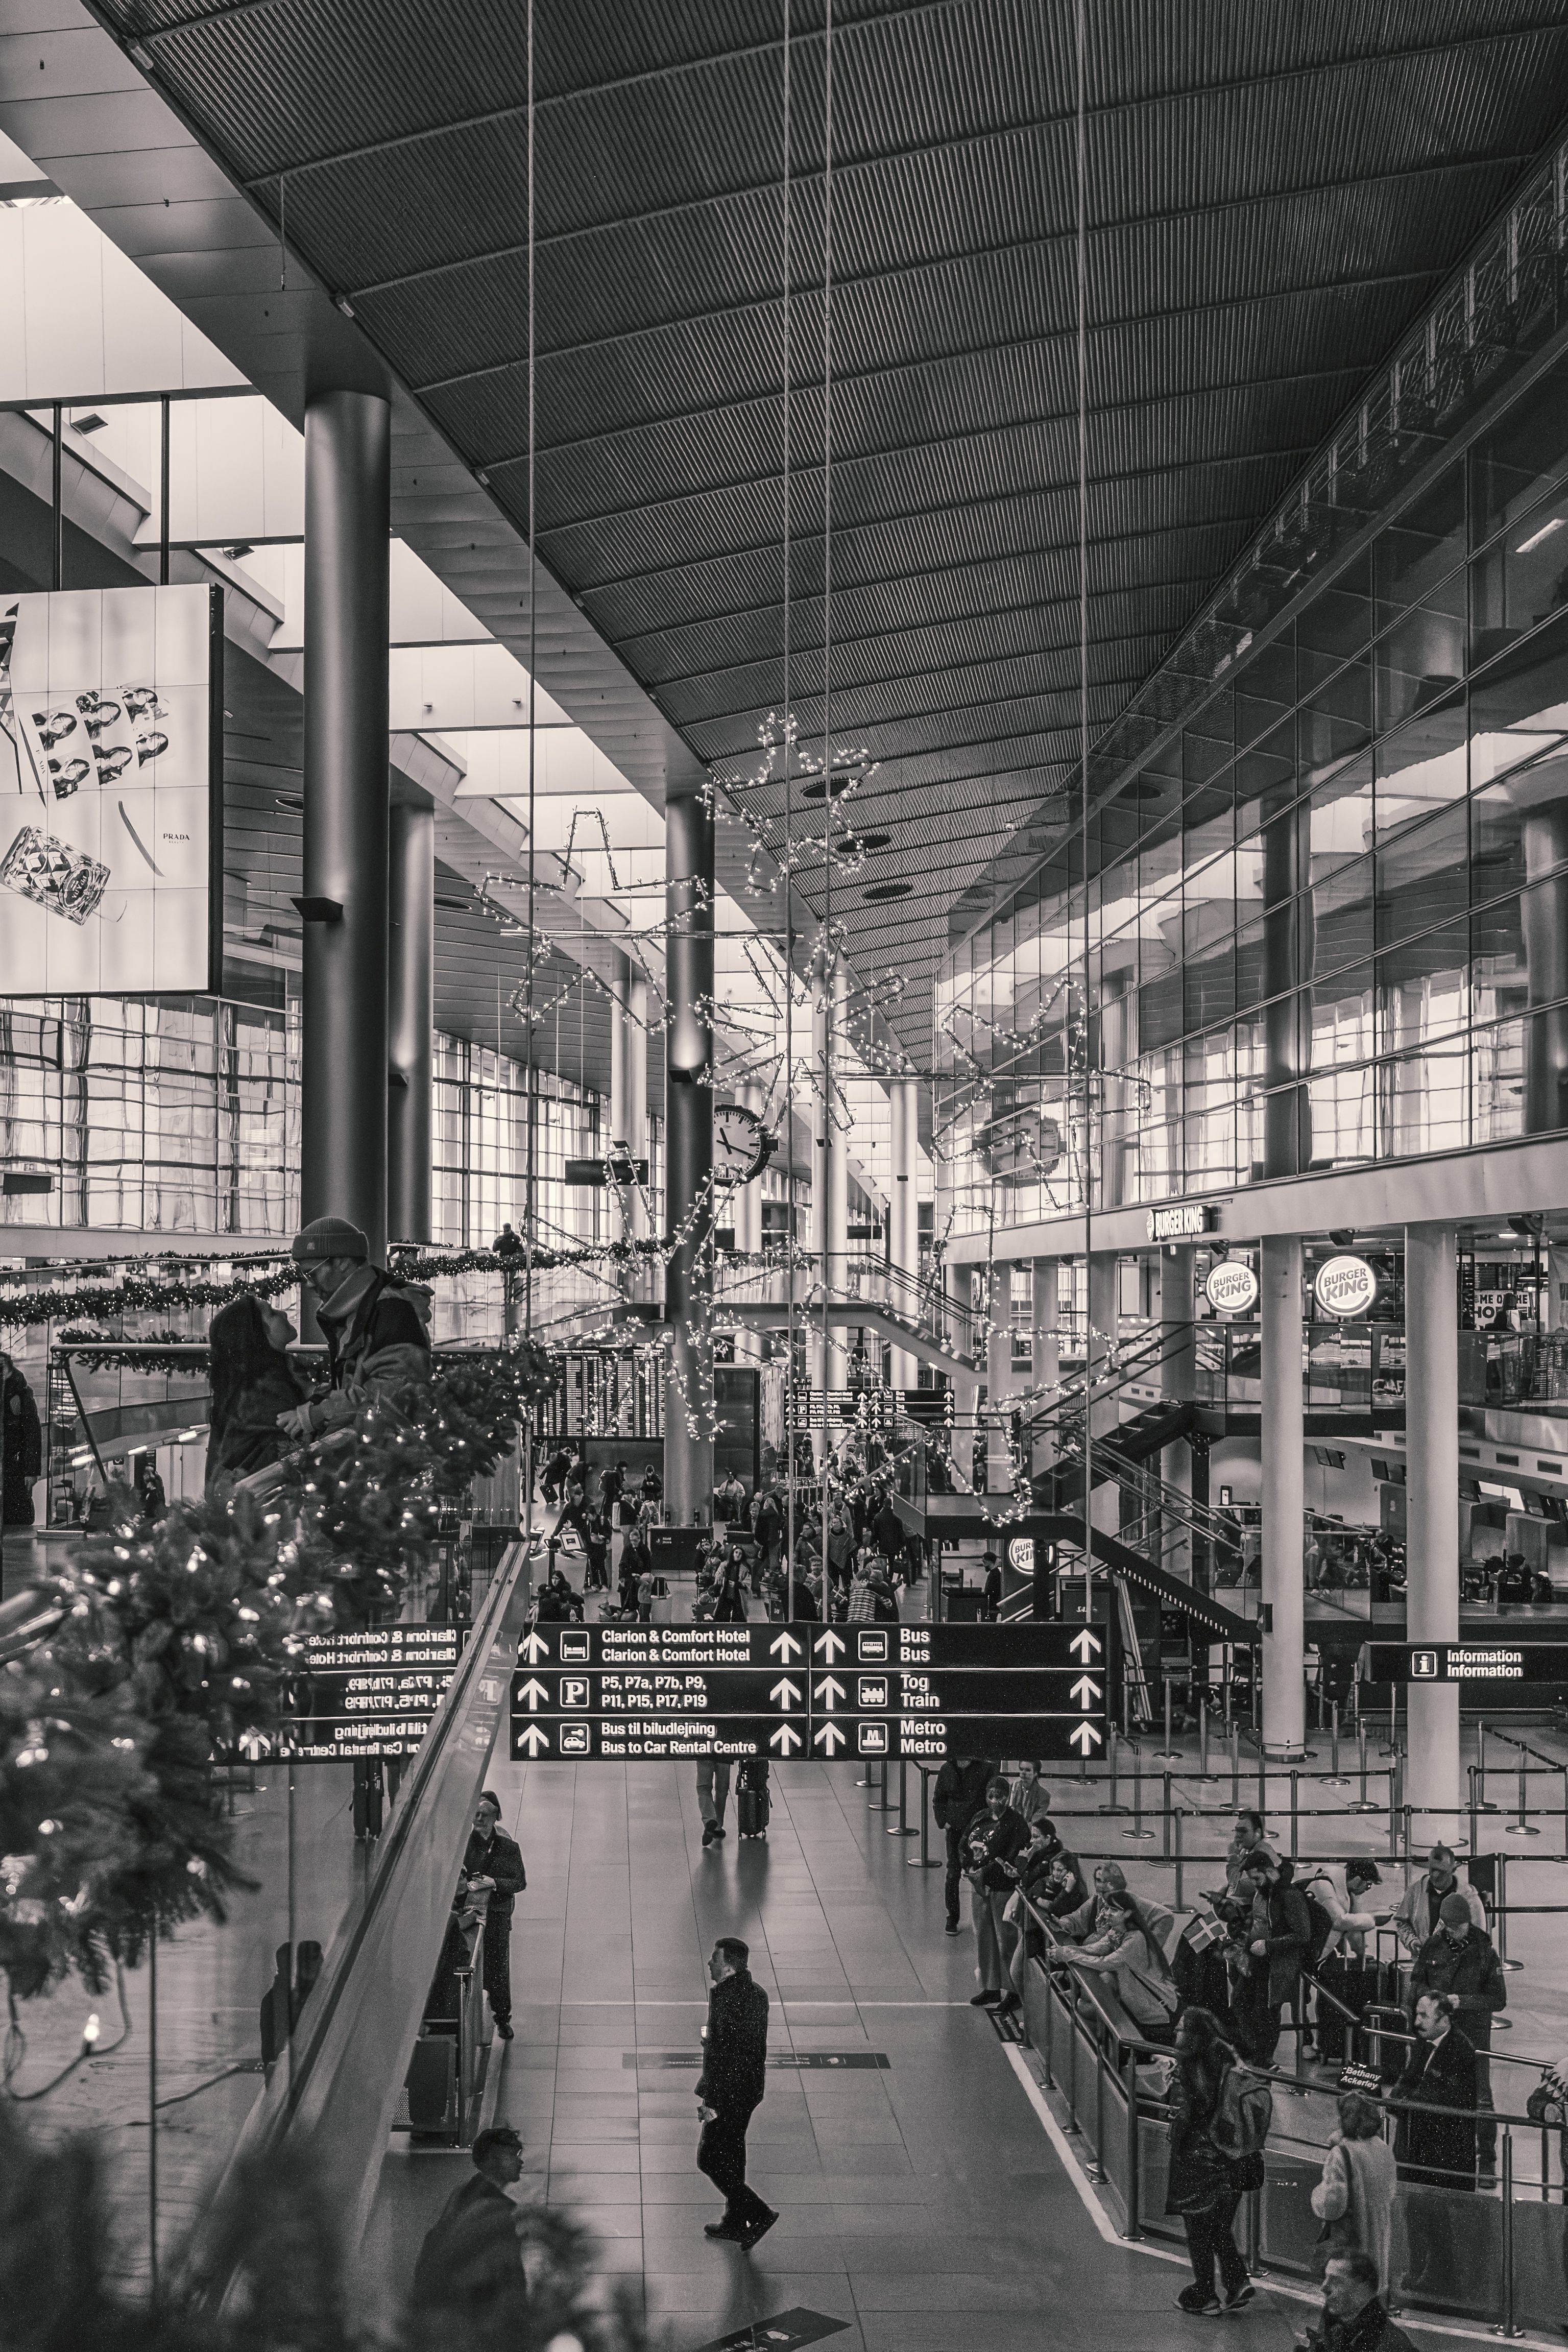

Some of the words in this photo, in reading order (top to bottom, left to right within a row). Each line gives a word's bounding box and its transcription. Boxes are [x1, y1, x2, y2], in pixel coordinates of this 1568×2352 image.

[1155, 1209, 1184, 1237] BURGER
[1184, 1206, 1203, 1234] KING
[1214, 1272, 1249, 1288] BURGER
[1324, 1268, 1366, 1287] BURGER
[1215, 1280, 1250, 1300] KING
[1324, 1278, 1368, 1302] KING
[1015, 1543, 1031, 1553] BUR
[602, 1630, 646, 1643] Clarion
[649, 1630, 660, 1643] &
[662, 1630, 714, 1643] Comfort
[717, 1630, 750, 1643] Hotel
[901, 1628, 930, 1643] Bus
[602, 1649, 646, 1662] Clarion
[649, 1649, 660, 1662] &
[662, 1649, 714, 1662] Comfort
[717, 1648, 750, 1661] Hotel
[901, 1647, 930, 1662] Bus
[1447, 1650, 1522, 1663] Information
[1447, 1665, 1523, 1677] Information
[602, 1676, 622, 1690] P5,
[625, 1676, 652, 1690] P7a,
[655, 1676, 683, 1690] P7b,
[686, 1676, 707, 1690] P9,
[900, 1674, 929, 1691] Tog
[602, 1695, 624, 1708] P11,
[628, 1695, 653, 1708] P15,
[656, 1694, 681, 1708] P17,
[684, 1694, 707, 1707] P19
[901, 1692, 939, 1708] Train
[602, 1722, 625, 1735] Bus
[628, 1722, 641, 1735] til
[643, 1722, 715, 1738] biludlejning
[901, 1720, 946, 1735] Metro
[601, 1741, 625, 1754] Bus
[628, 1741, 641, 1754] to
[644, 1741, 666, 1754] Car
[670, 1741, 711, 1754] Rental
[714, 1741, 757, 1754] Centre
[901, 1739, 946, 1754] Metro
[1346, 2067, 1382, 2081] Bethany
